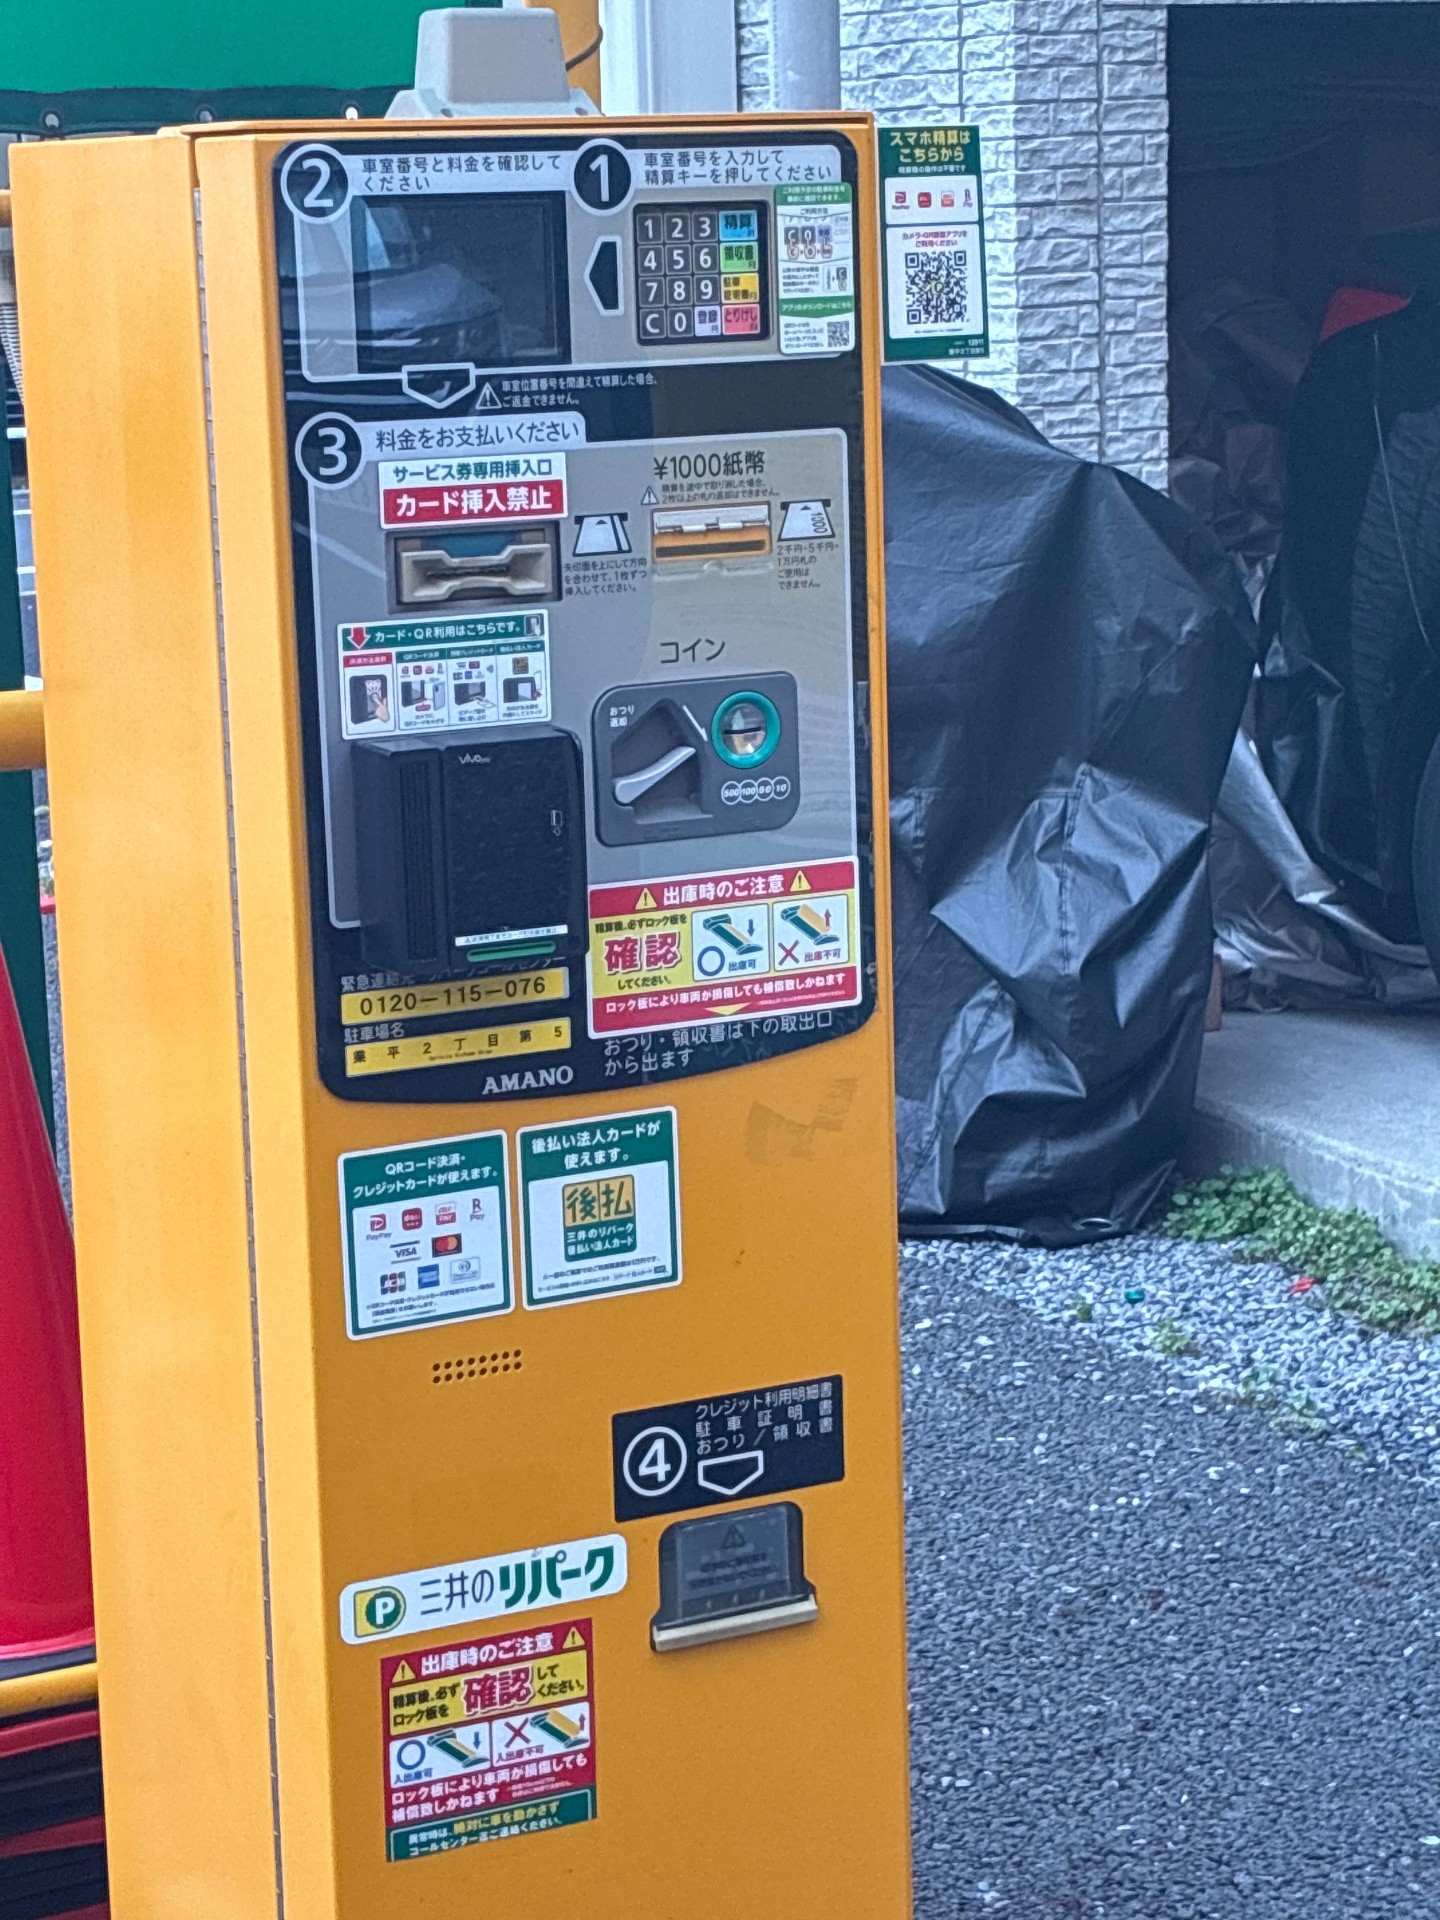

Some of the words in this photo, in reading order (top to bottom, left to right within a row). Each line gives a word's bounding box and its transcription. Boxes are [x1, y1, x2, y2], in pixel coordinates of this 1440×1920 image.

[890, 129, 971, 146] スマホ精算は
[362, 154, 561, 174] 車室番号と料金を確認して
[644, 149, 783, 167] 車室番号を入力して
[900, 146, 964, 162] こちらから
[302, 158, 334, 207] 2
[364, 175, 430, 193] ください
[589, 154, 610, 201] 1
[644, 166, 831, 185] 精算キーを押してください
[644, 219, 653, 239] 1
[671, 218, 684, 238] 2
[699, 217, 711, 237] 3
[643, 250, 657, 270] 4
[673, 249, 685, 270] 5
[700, 248, 712, 269] 6
[646, 282, 658, 302] 7
[673, 281, 686, 301] 8
[700, 279, 712, 300] 9
[646, 313, 660, 334] C
[674, 312, 687, 332] 0
[725, 308, 758, 323] とりけし
[503, 392, 580, 408] ご返金できません。
[376, 420, 580, 452] 料金をお支払いください
[317, 426, 348, 476] 3
[393, 459, 552, 484] サービス券専用挿入口
[654, 450, 765, 480] ¥1000紙幣
[396, 486, 553, 518] カード挿入禁止
[564, 583, 637, 597] 挿入してください。
[375, 620, 521, 642] カード・QR利用はこちらです。
[660, 637, 726, 664] コイン
[609, 704, 635, 716] おつり
[724, 788, 740, 798] 500
[742, 787, 756, 796] 100
[759, 785, 772, 794] 50
[776, 783, 787, 792] 10
[663, 873, 785, 907] 出庫時のご注意
[604, 932, 681, 973] 確認
[803, 948, 842, 963] 出庫不可
[728, 959, 757, 973] 出庫可
[344, 1022, 406, 1043] 駐車場名
[604, 1010, 832, 1056] おつり・領収書は下の取出口
[605, 1048, 694, 1076] から出ます
[482, 1065, 574, 1095] AMANO
[531, 1120, 661, 1155] 後払い法人カードが
[564, 1149, 629, 1170] 使えます。
[353, 1166, 498, 1199] クレジットカードが使えます。
[566, 1180, 632, 1223] 後払
[566, 1222, 634, 1243] 三井のリパーク
[394, 1246, 418, 1258] VISA
[696, 1381, 833, 1419] クレジット利用明細書
[696, 1399, 833, 1438] 駐車証明書
[638, 1437, 671, 1482] 4
[420, 1545, 614, 1615] 三井のリパーク
[420, 1632, 555, 1676] 出庫時のご注意
[537, 1663, 559, 1679] して
[463, 1666, 533, 1715] 確認
[392, 1703, 450, 1727] ロック板を
[391, 1752, 587, 1806] ロック板により車両が損傷しても
[392, 1787, 499, 1823] 補償致しかねます
